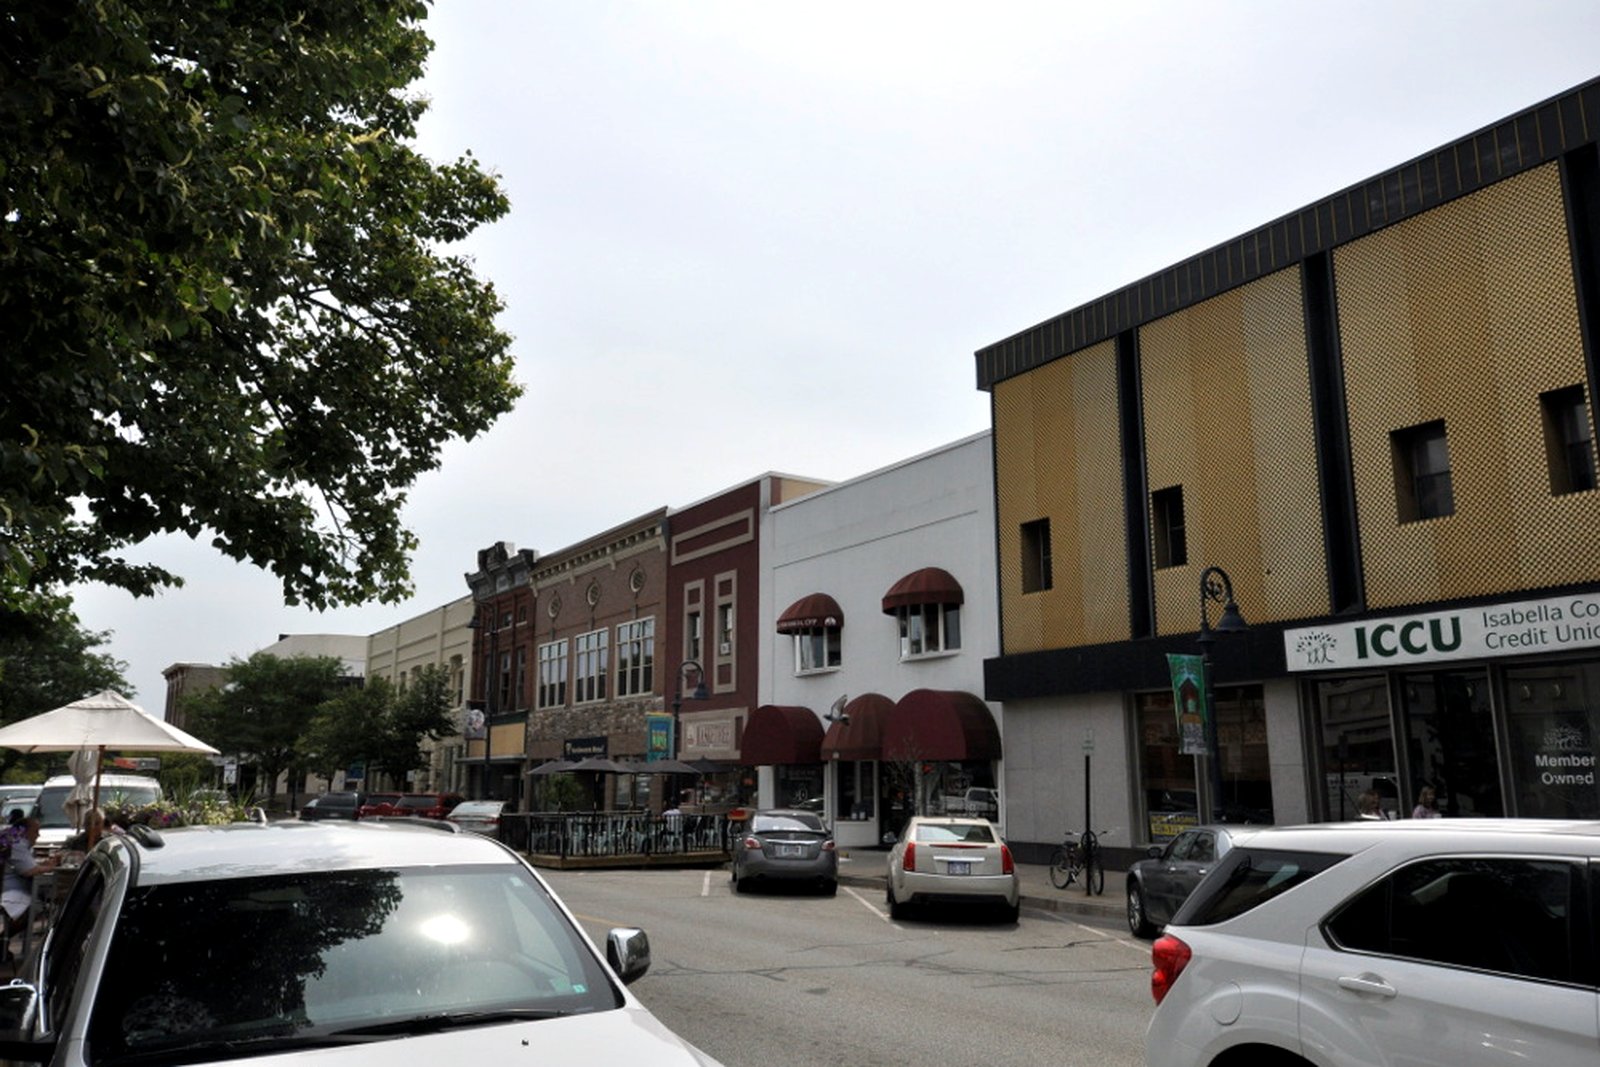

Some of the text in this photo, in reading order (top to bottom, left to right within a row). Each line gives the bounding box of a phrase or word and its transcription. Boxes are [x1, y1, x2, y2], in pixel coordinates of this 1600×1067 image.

[1483, 600, 1600, 628] Isabella Co
[1355, 616, 1462, 659] ICCU
[1485, 628, 1548, 649] Credit
[1535, 754, 1596, 767] Member
[1541, 771, 1595, 785] Owned
